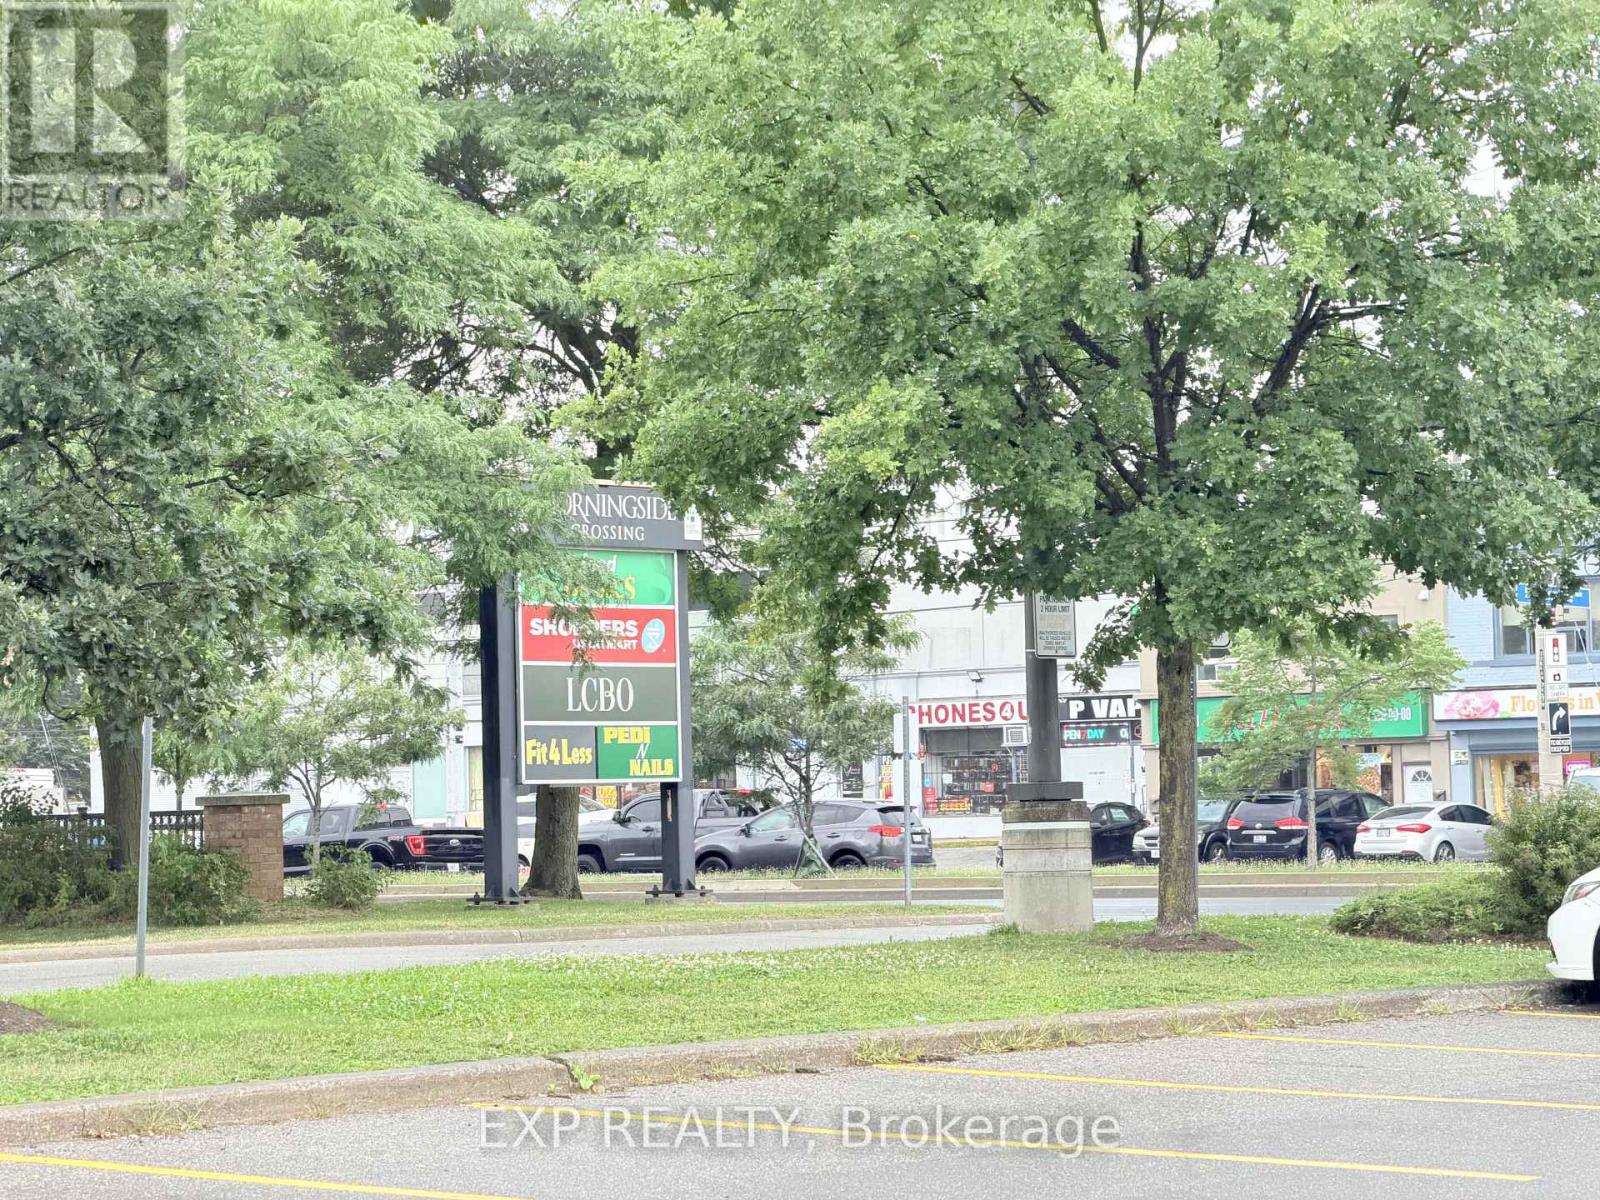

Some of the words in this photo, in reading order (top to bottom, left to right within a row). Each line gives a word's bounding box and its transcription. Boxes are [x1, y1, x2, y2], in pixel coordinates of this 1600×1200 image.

[567, 677, 634, 712] LCBO
[603, 726, 651, 744] PEDI
[635, 743, 651, 759] N
[629, 758, 674, 776] NAILS
